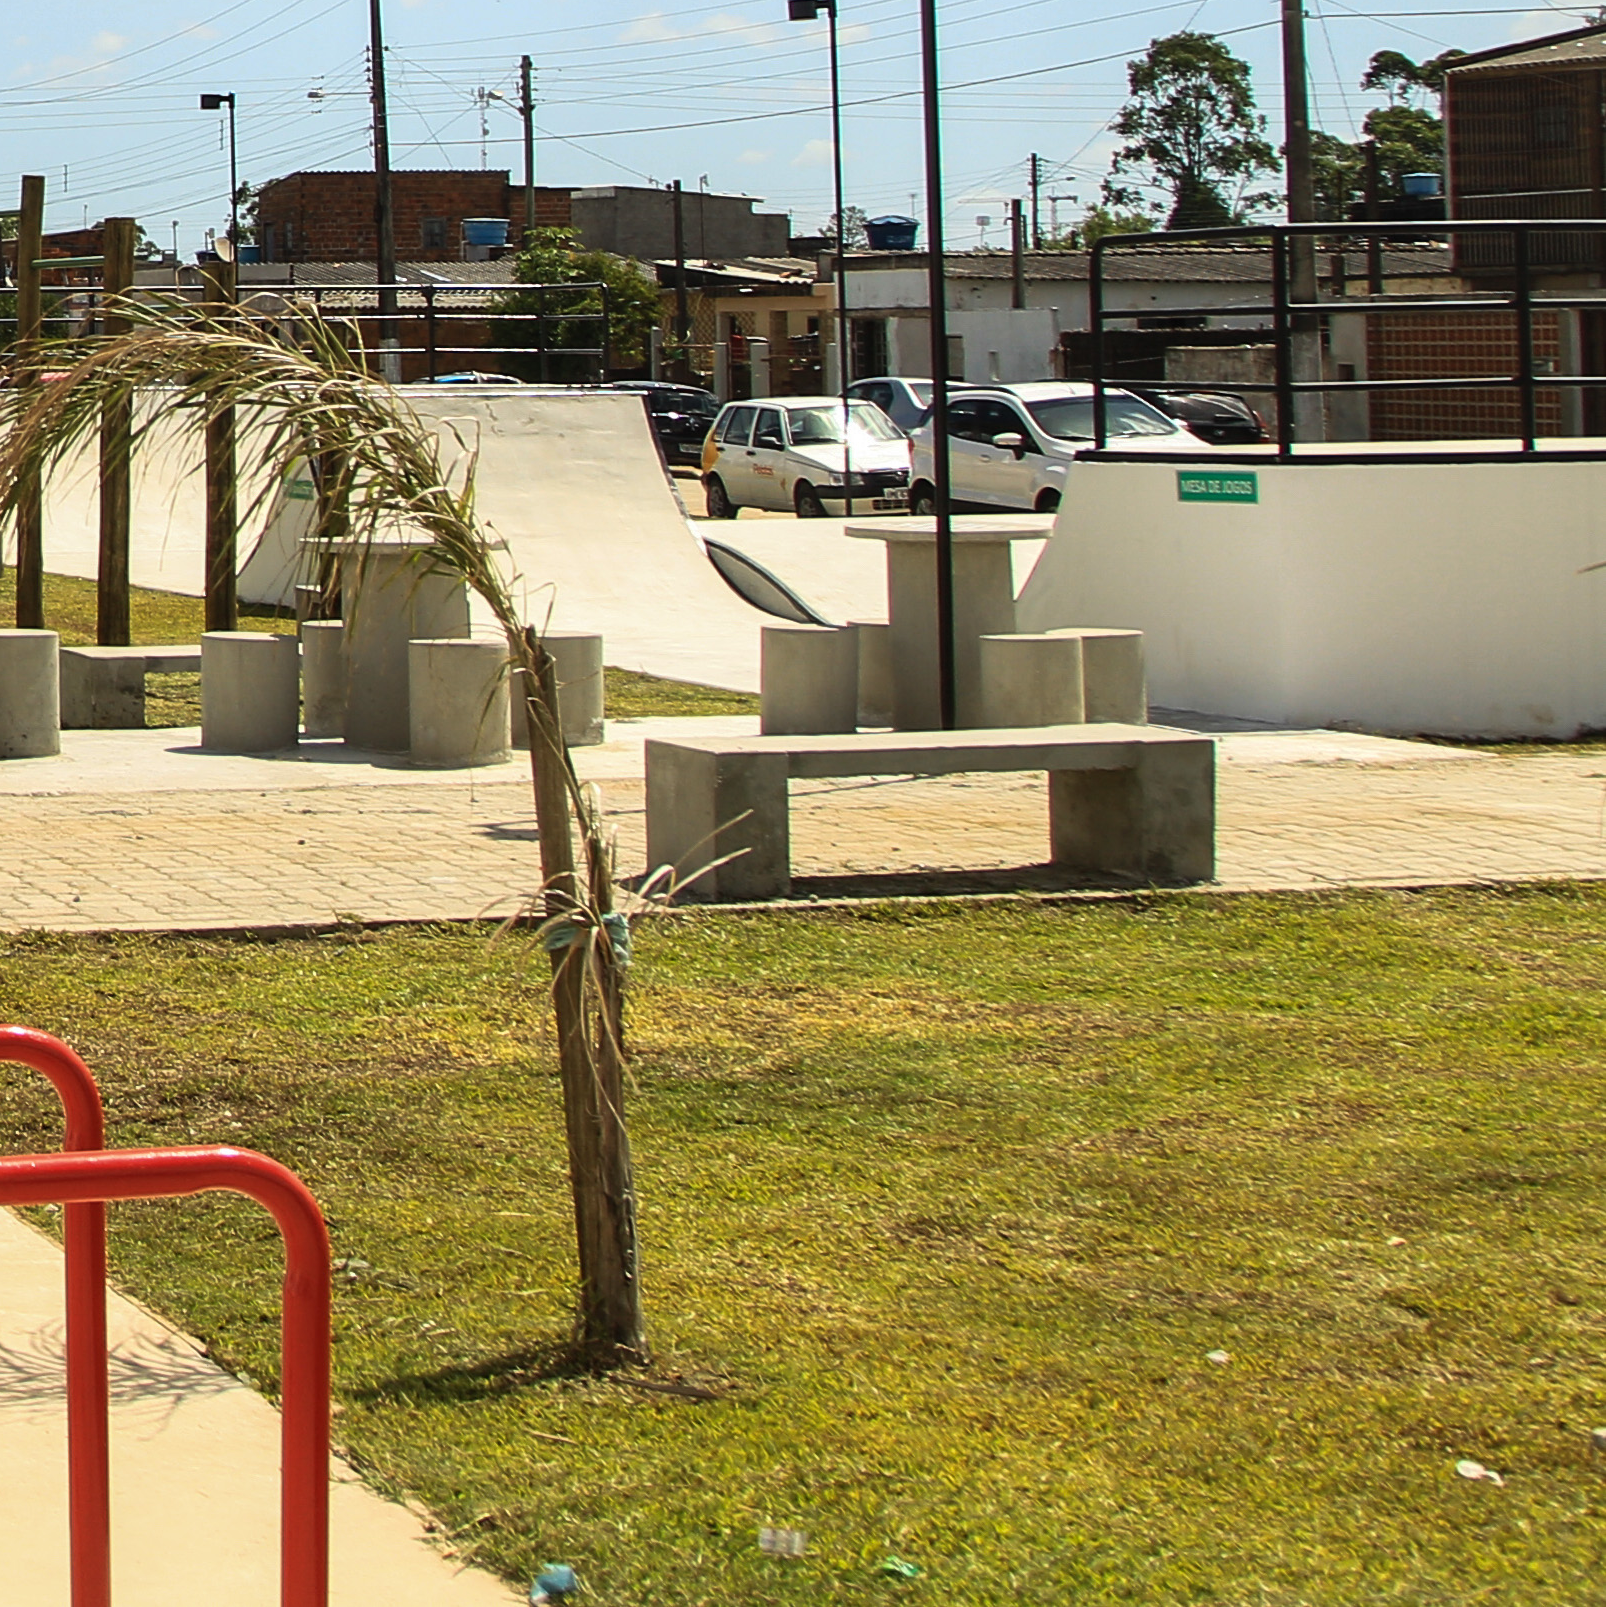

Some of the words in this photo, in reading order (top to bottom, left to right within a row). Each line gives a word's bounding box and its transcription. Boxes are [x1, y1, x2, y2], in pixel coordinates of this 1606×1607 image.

[1181, 480, 1207, 492] MESA
[1208, 481, 1220, 493] DE
[1222, 481, 1253, 494] JOGOS
